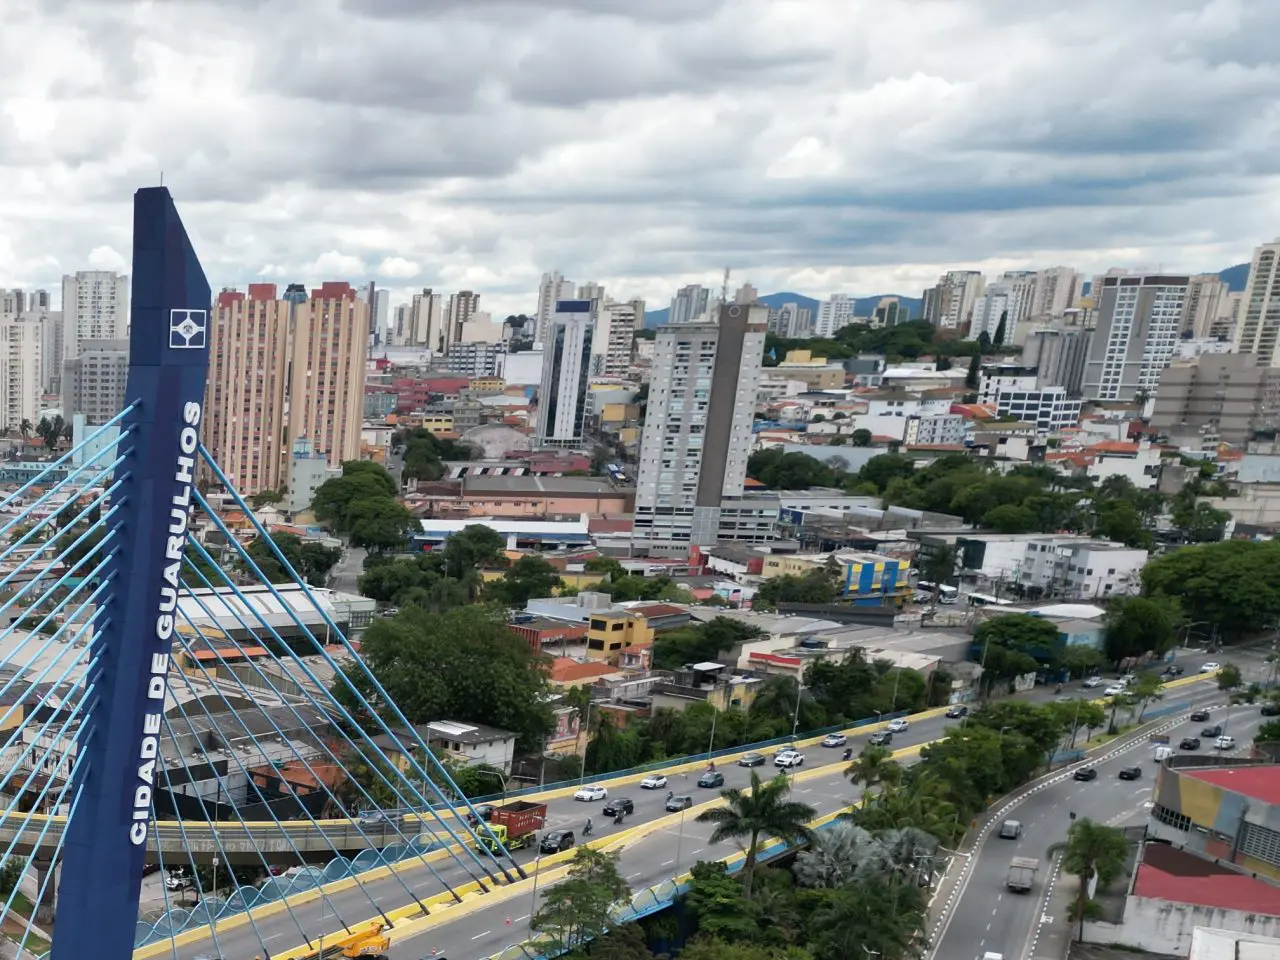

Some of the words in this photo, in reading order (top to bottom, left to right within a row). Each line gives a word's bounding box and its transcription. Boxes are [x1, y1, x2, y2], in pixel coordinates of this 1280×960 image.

[156, 401, 201, 640] GUARULHOS
[148, 652, 169, 700] DE
[130, 713, 161, 846] CIDADE
